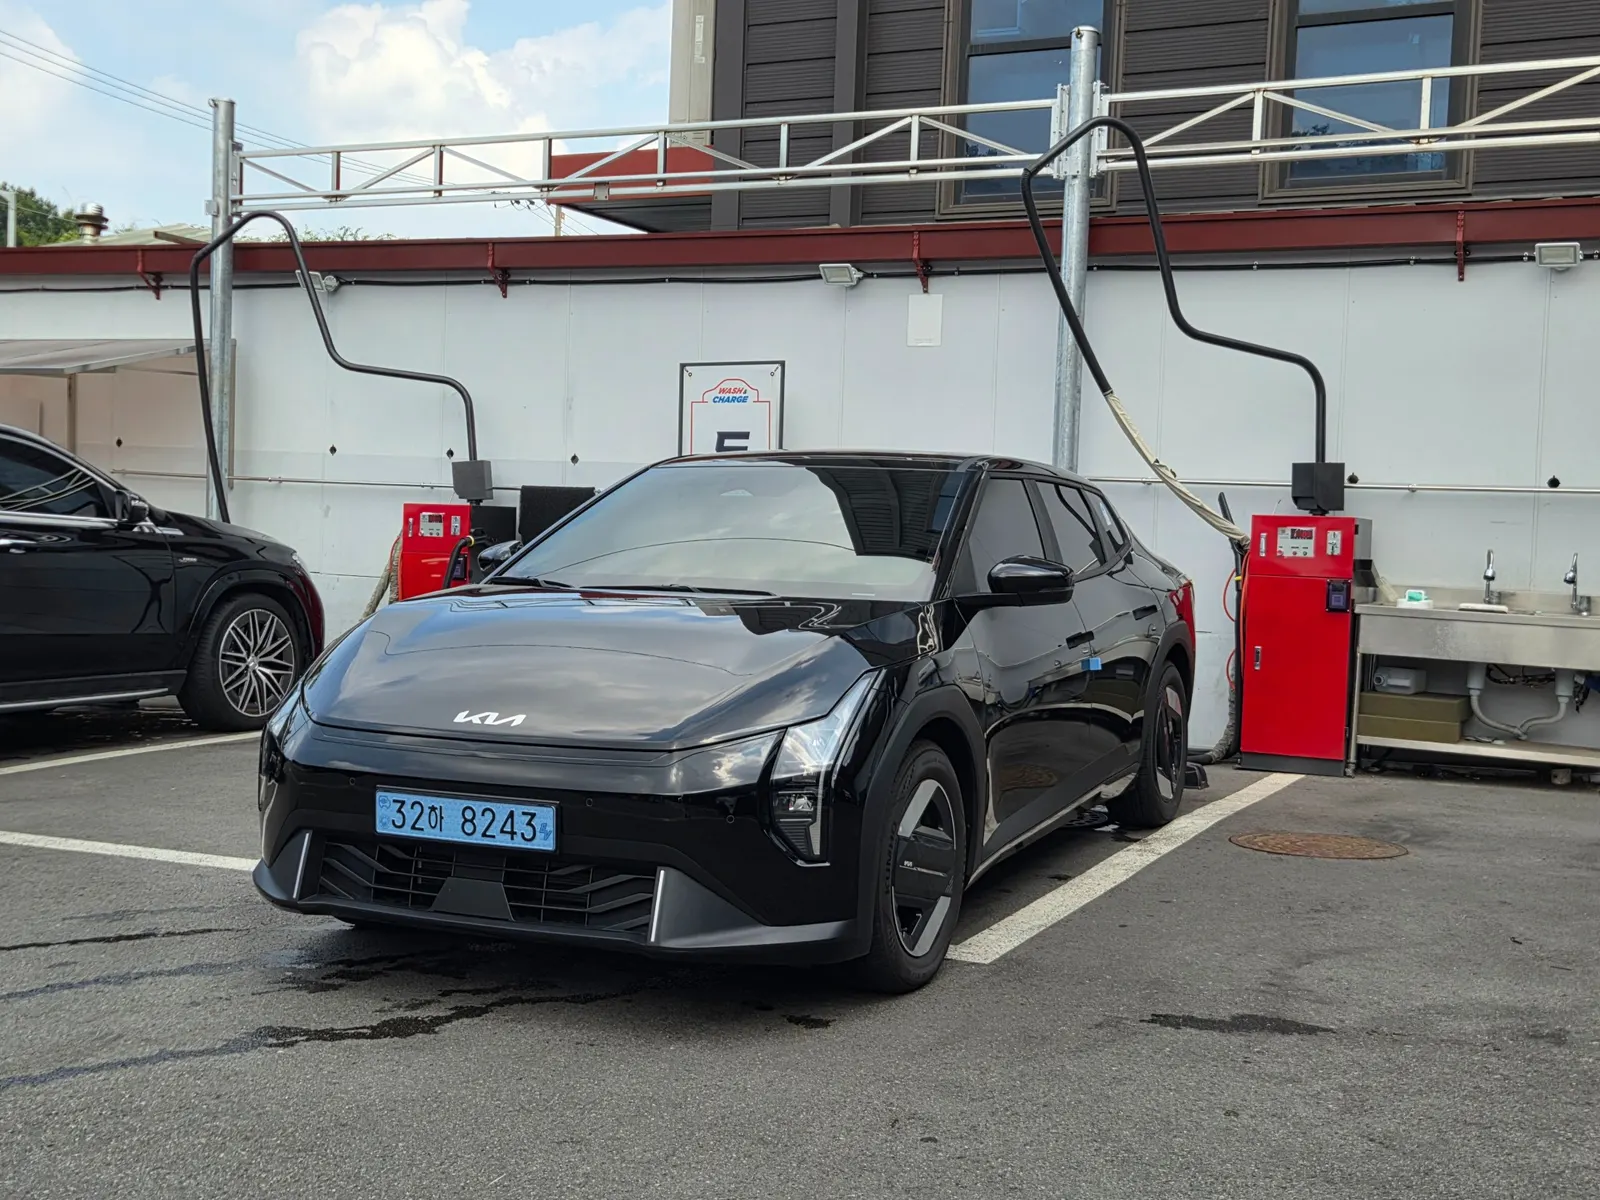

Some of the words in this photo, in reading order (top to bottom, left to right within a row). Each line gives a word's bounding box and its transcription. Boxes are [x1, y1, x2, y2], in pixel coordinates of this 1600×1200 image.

[712, 395, 749, 403] CHARGE
[391, 799, 444, 832] 32하
[461, 805, 537, 842] 8243
